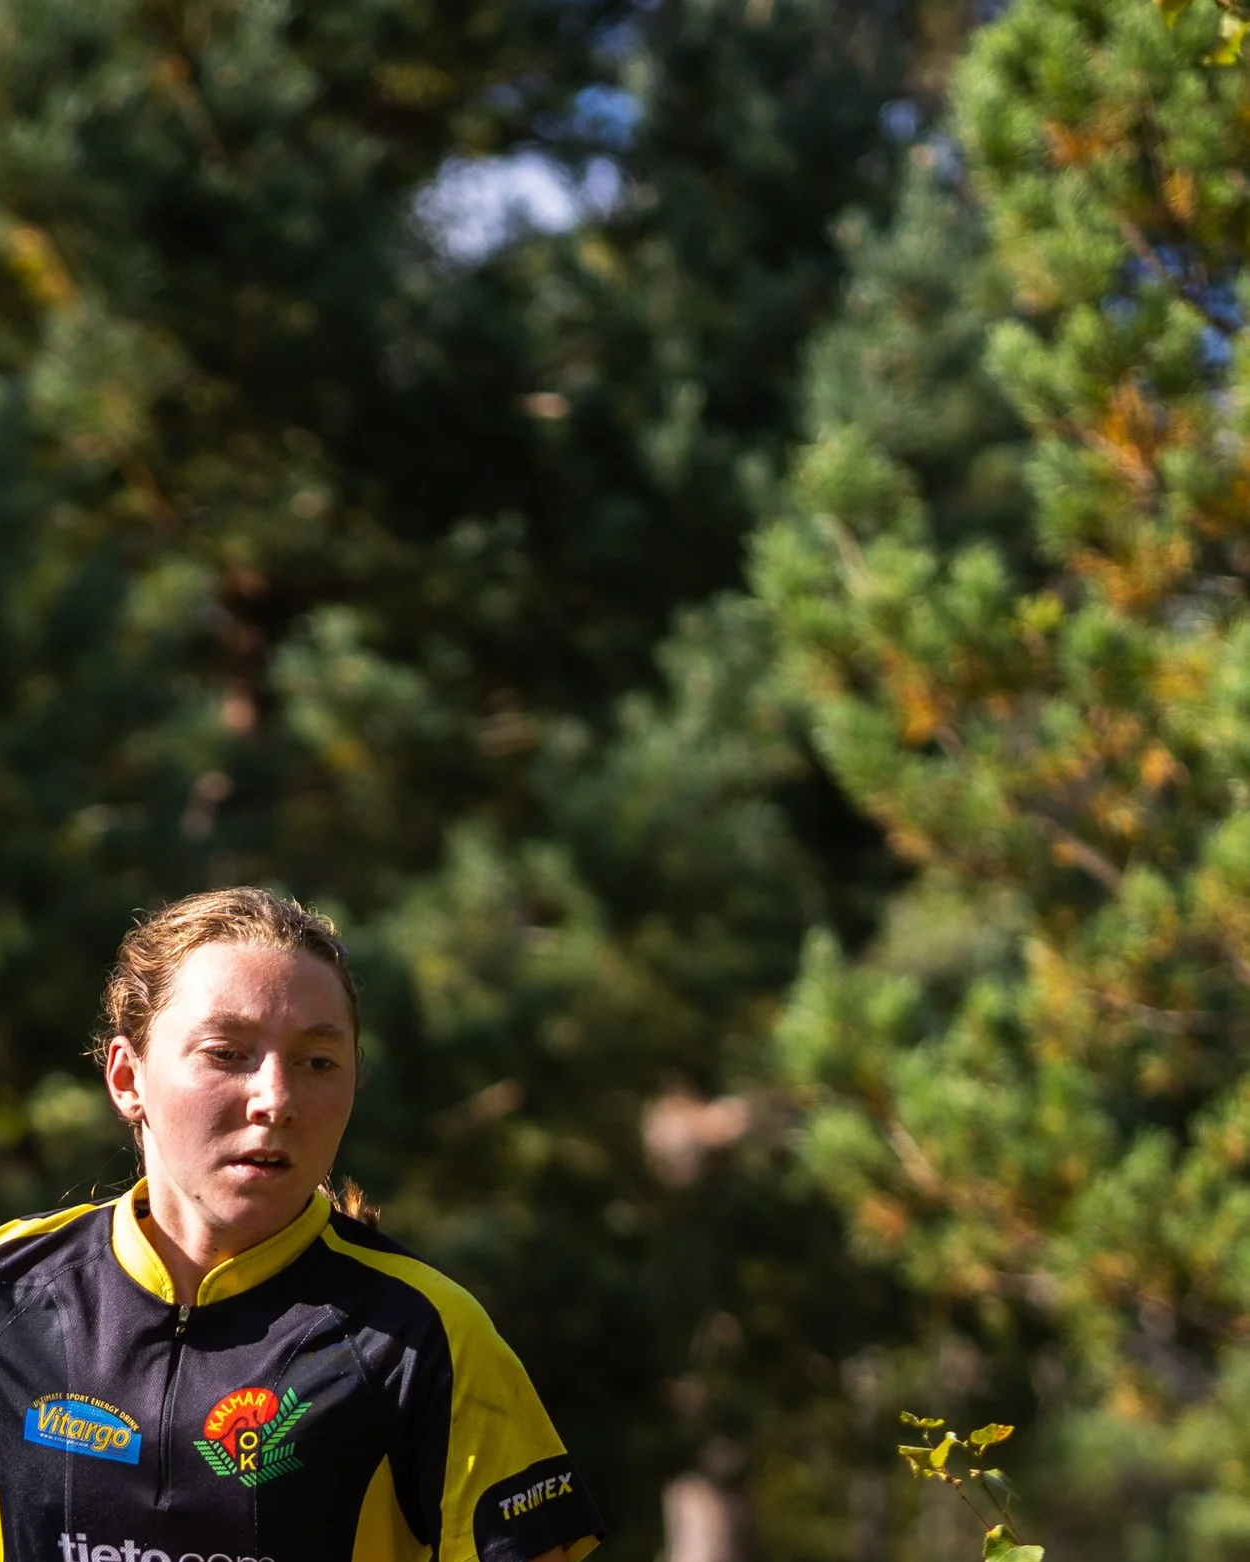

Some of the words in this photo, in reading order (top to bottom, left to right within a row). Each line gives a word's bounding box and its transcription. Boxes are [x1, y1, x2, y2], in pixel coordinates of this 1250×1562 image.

[33, 1392, 63, 1408] ULTIMATE
[66, 1393, 89, 1403] SPORT
[91, 1398, 120, 1415] ENERGY
[119, 1411, 140, 1431] DRINK
[38, 1403, 131, 1451] Vitargo
[207, 1391, 266, 1431] KALMAR
